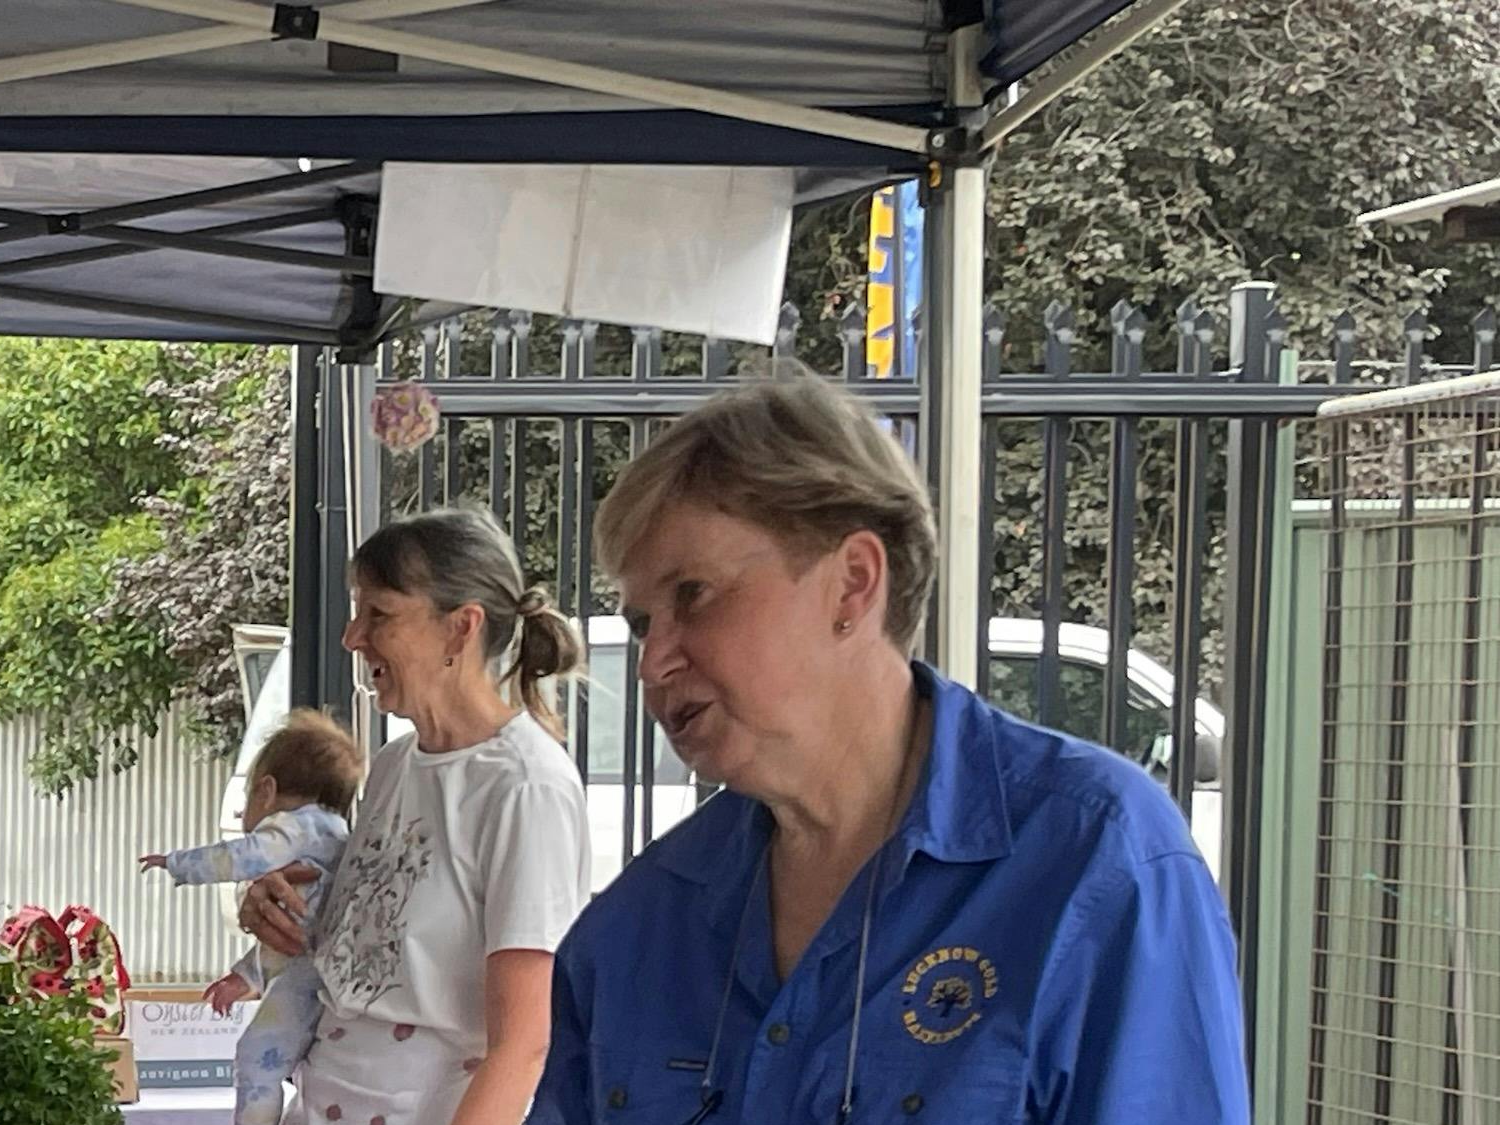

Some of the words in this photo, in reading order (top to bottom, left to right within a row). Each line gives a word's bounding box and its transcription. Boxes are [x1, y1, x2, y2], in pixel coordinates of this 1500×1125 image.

[903, 947, 979, 994] LUCKNOW
[979, 959, 998, 998] GOLD
[181, 1026, 239, 1036] ZEALAND
